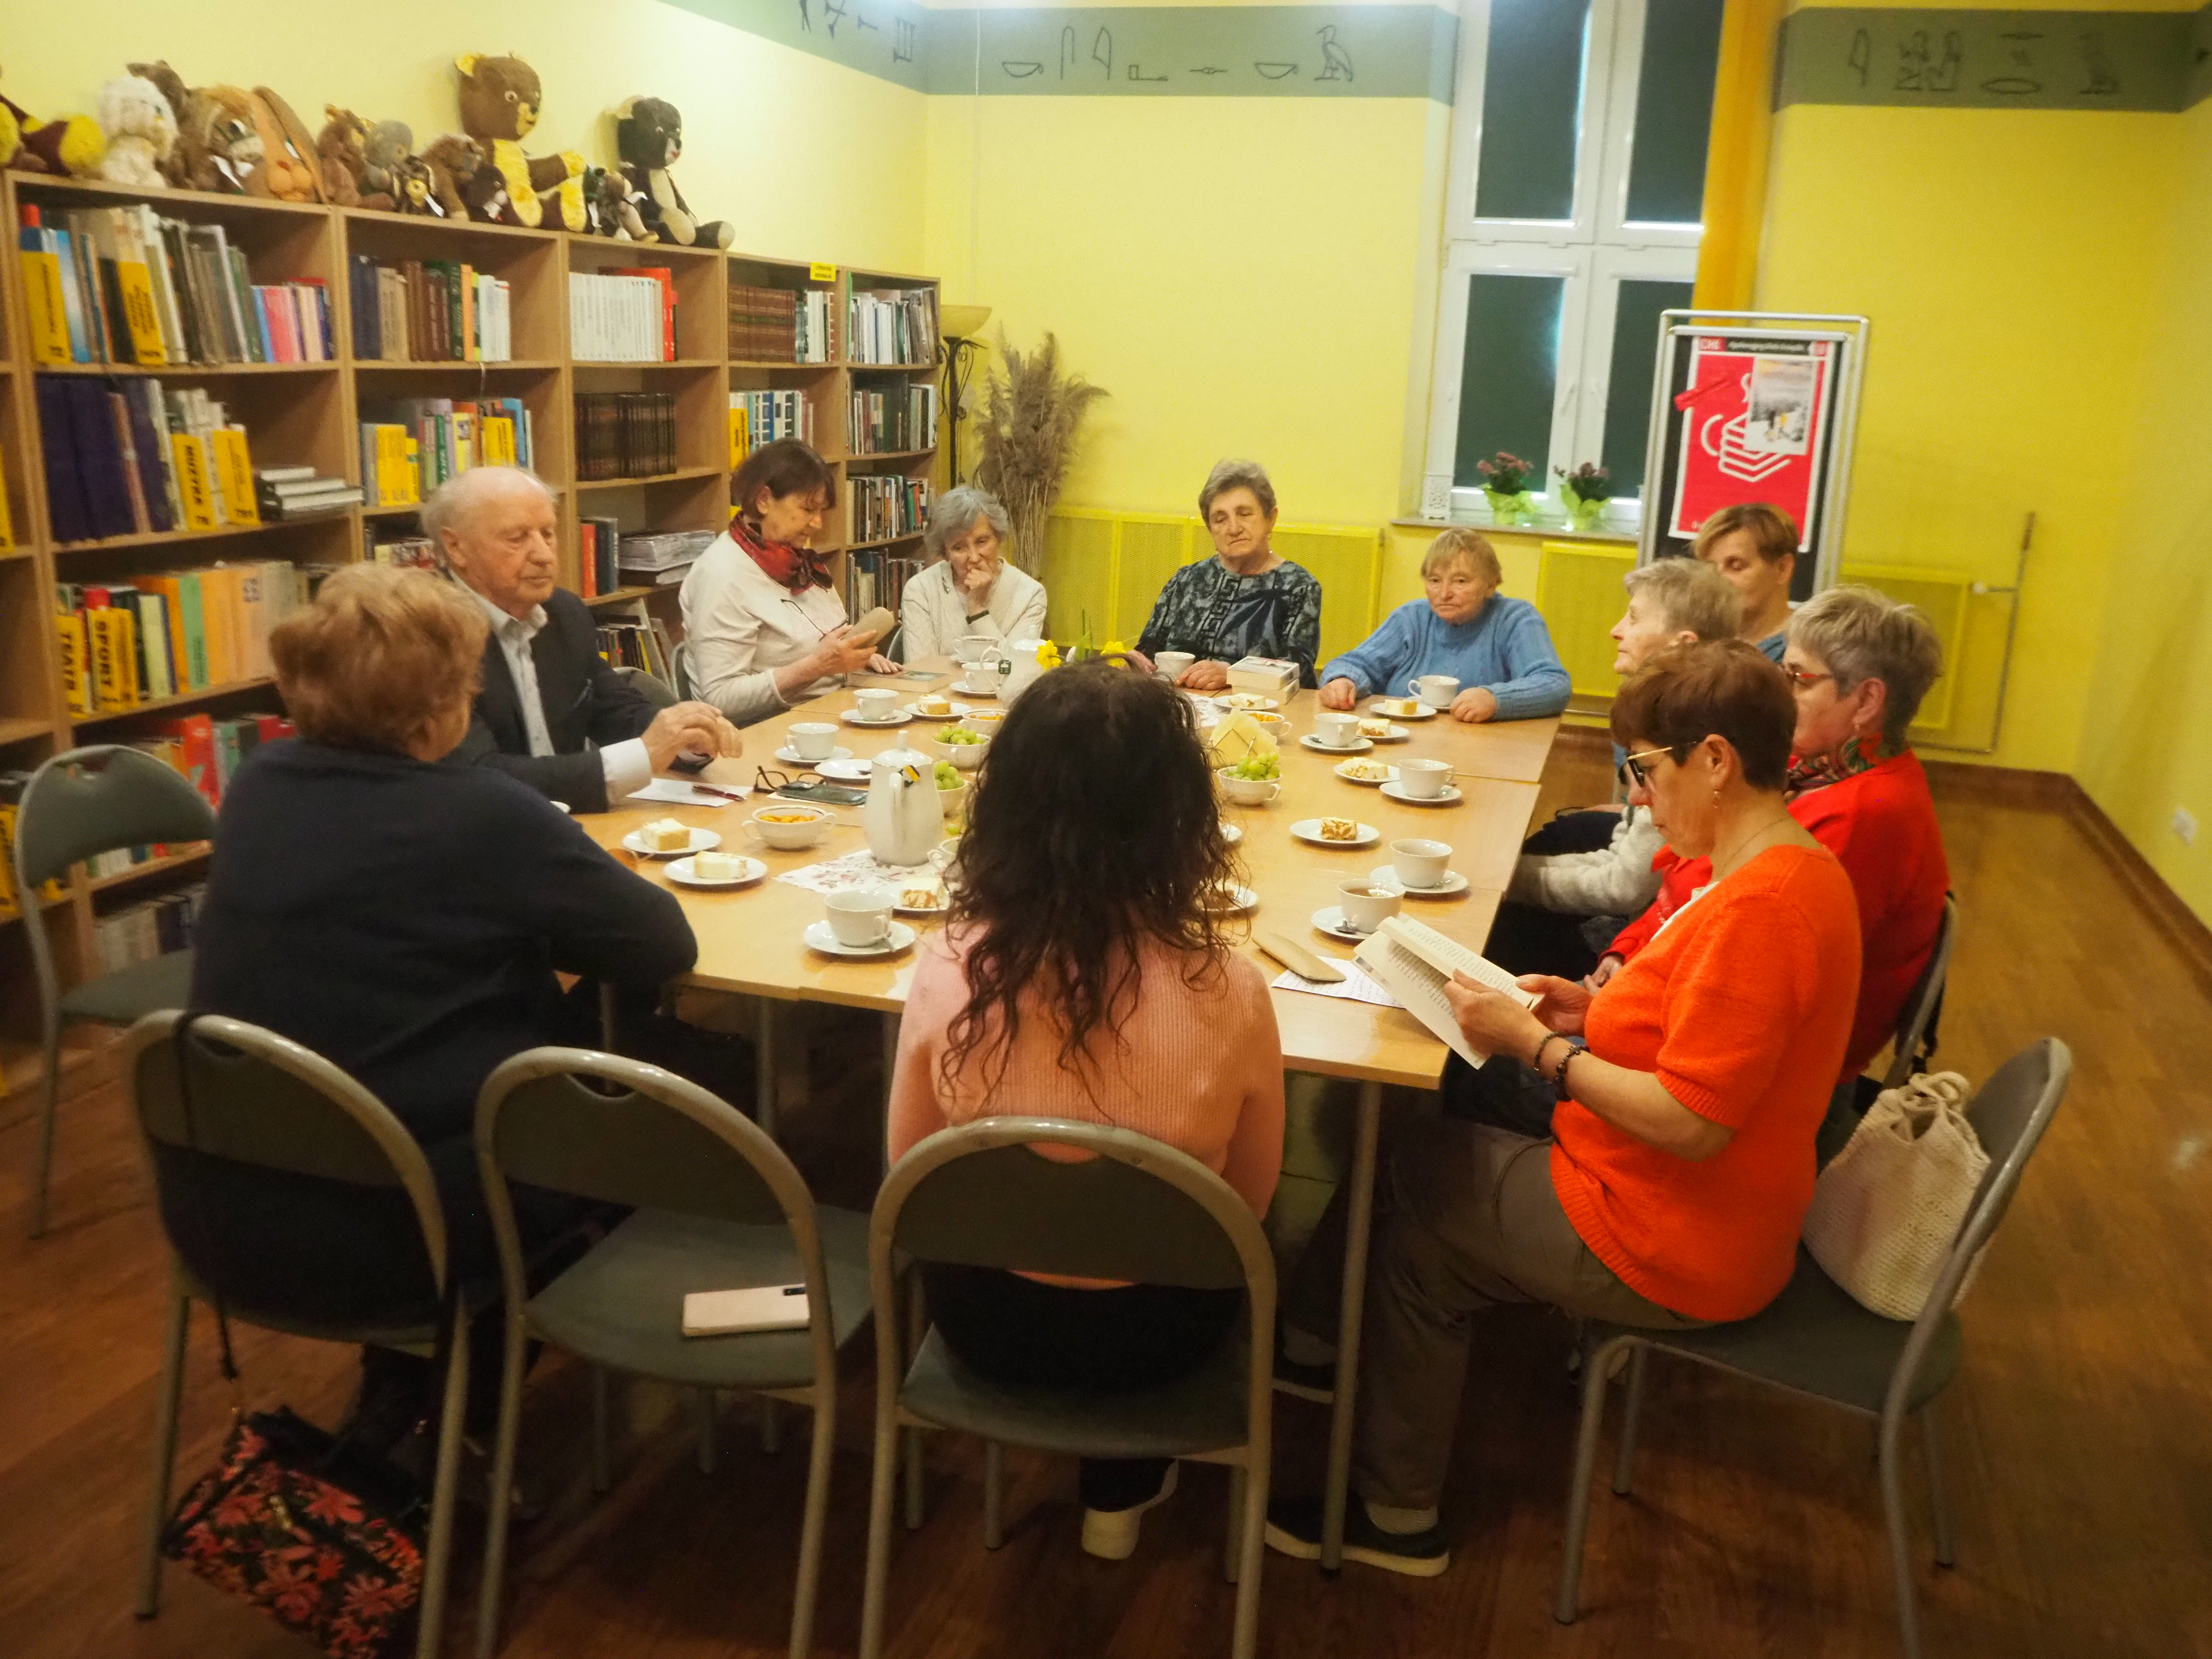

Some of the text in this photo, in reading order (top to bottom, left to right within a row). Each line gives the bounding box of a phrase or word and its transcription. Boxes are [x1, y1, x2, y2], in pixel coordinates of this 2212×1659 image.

[185, 445, 203, 505] MUZYKA
[61, 632, 76, 690] TEATR
[95, 621, 113, 687] SPORT
